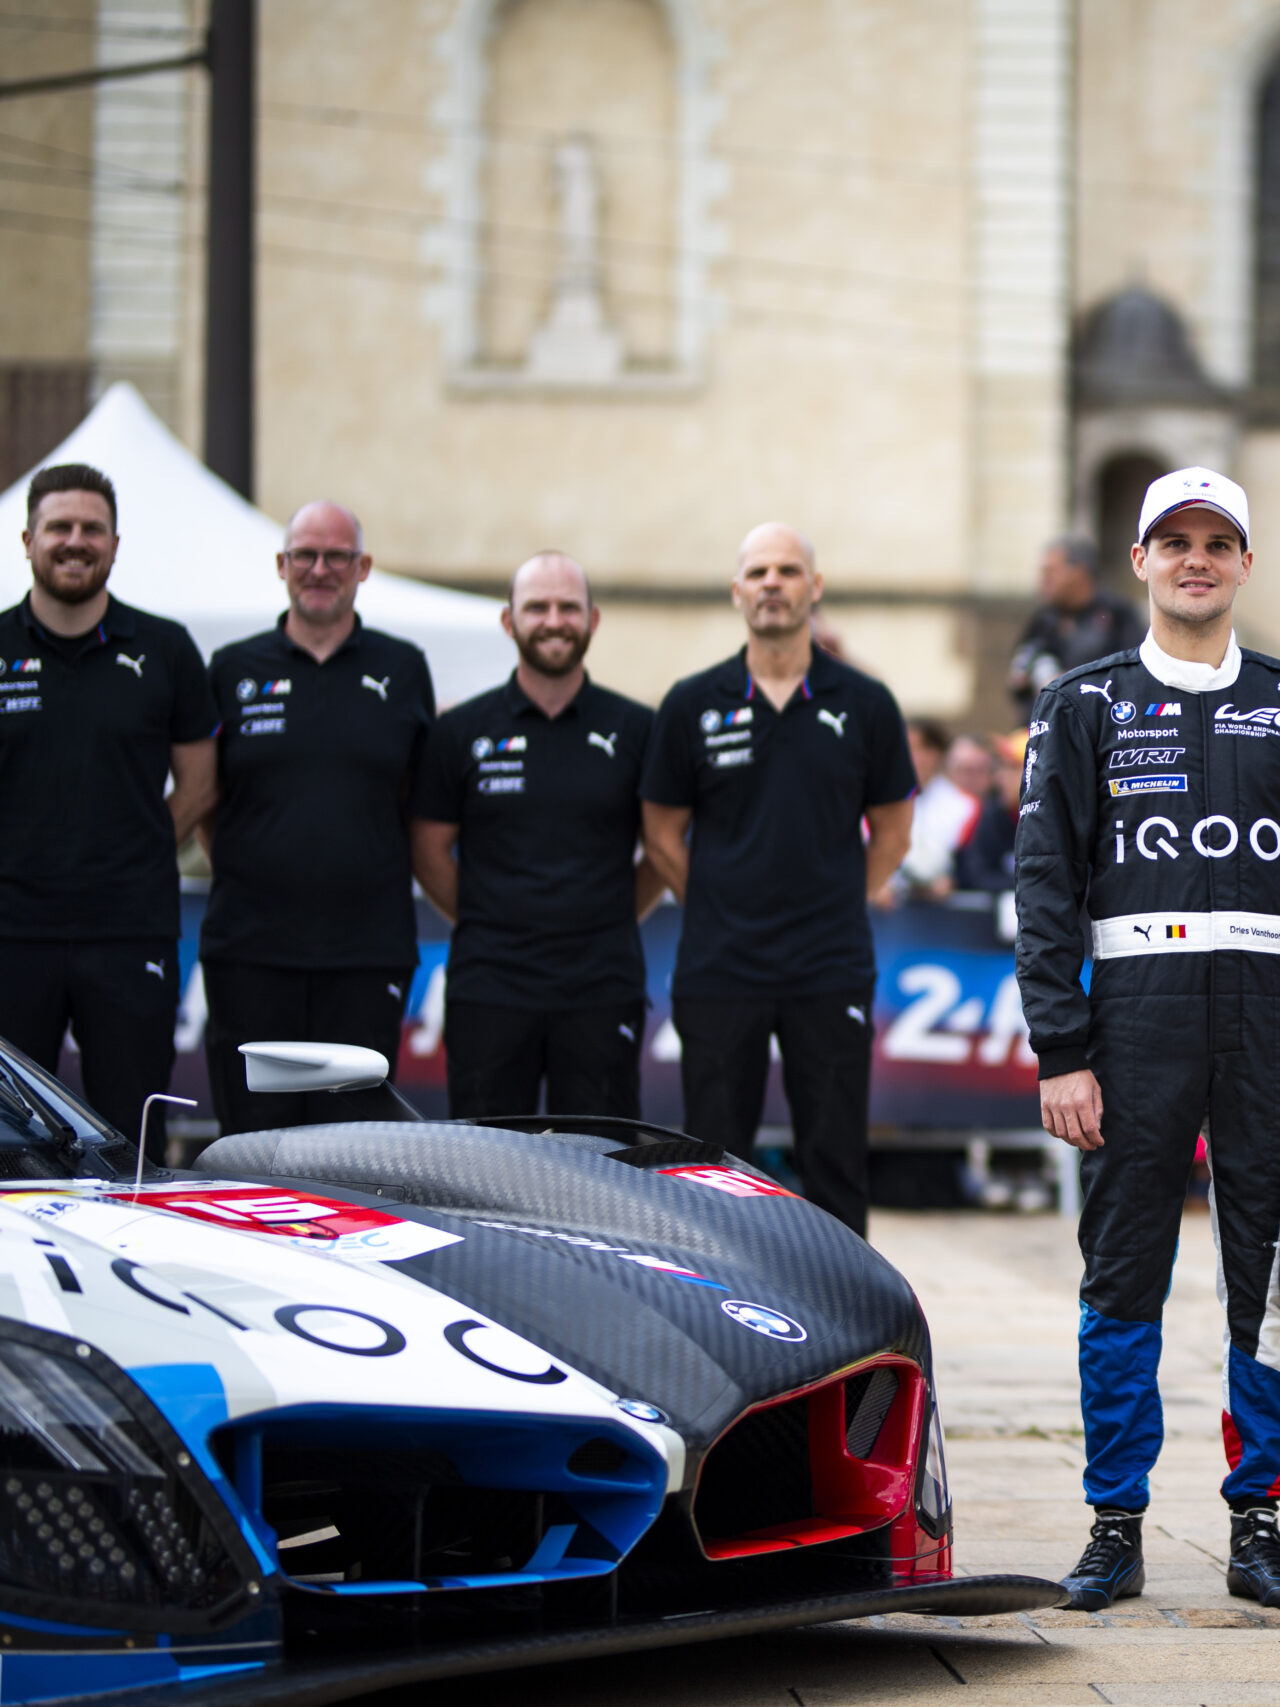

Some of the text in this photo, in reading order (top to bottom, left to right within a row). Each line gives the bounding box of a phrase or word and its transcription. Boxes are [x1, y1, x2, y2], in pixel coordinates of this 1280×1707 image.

[1160, 702, 1182, 717] M
[1227, 723, 1253, 731] WORLD
[1117, 727, 1179, 740] Motorsport
[1214, 729, 1267, 738] CHAMPIONSHIP
[1109, 747, 1186, 769] WRT
[1130, 780, 1180, 789] MICHELIN
[1229, 925, 1250, 934] Dries
[165, 1196, 340, 1222] 15
